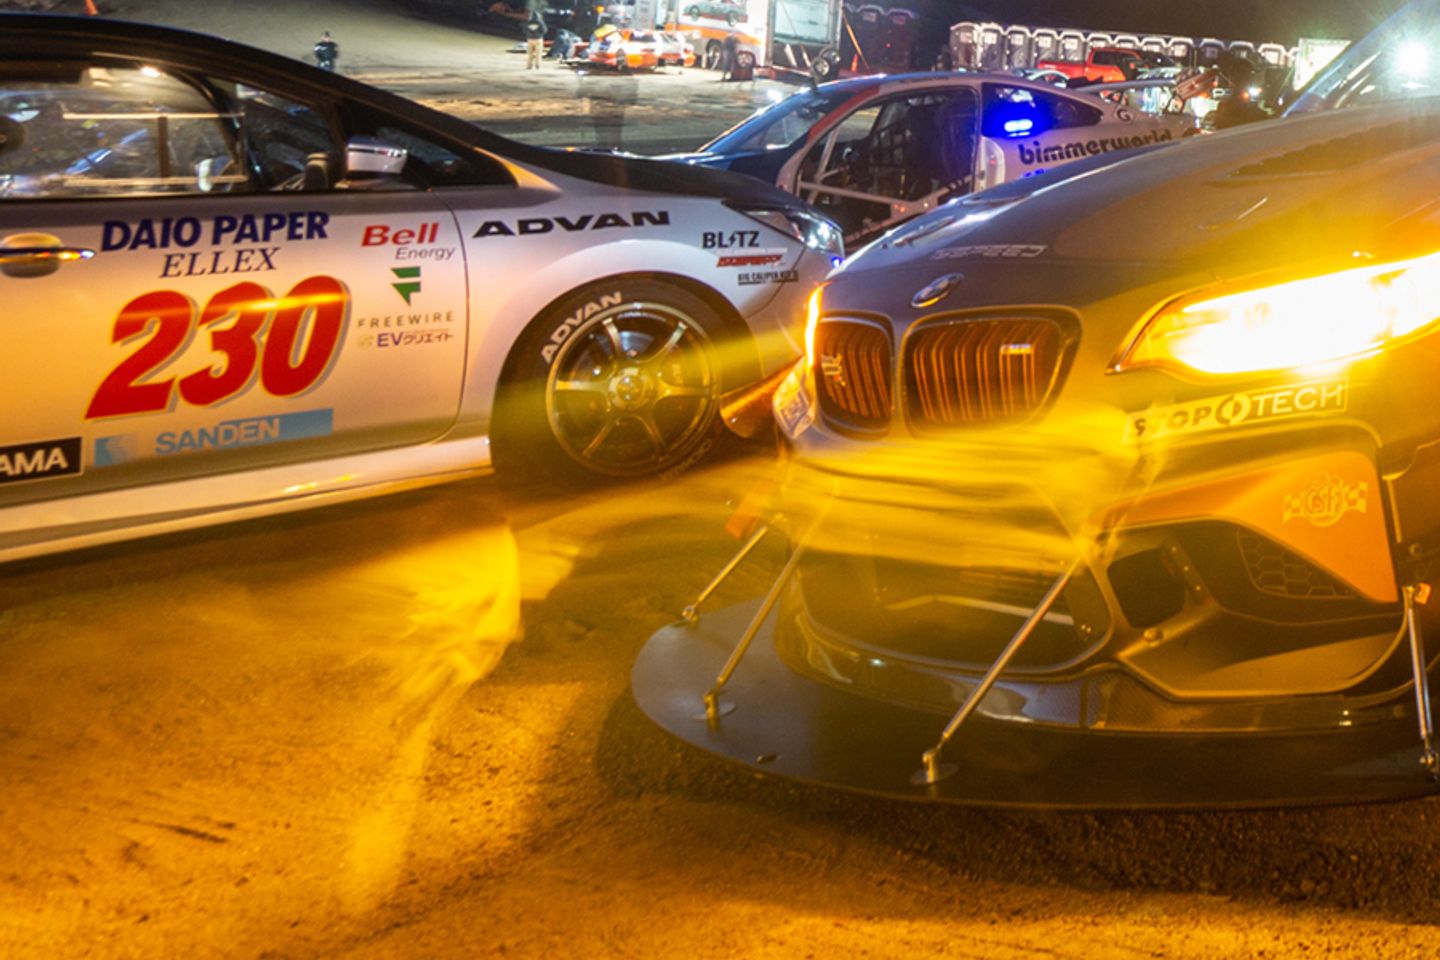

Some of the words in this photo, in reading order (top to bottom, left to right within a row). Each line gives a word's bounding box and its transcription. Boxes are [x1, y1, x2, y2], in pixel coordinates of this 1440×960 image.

[1018, 128, 1172, 165] bimmerworld
[101, 217, 200, 252] DAIO
[211, 211, 330, 245] PAPER
[362, 223, 440, 247] Bell
[473, 211, 670, 238] ADVAN
[159, 247, 281, 278] ELLEX
[395, 247, 455, 261] Energy
[358, 311, 454, 328] FREEWIRE
[541, 291, 622, 364] ADVAN
[84, 275, 350, 420] 230
[154, 417, 281, 456] SANDEN
